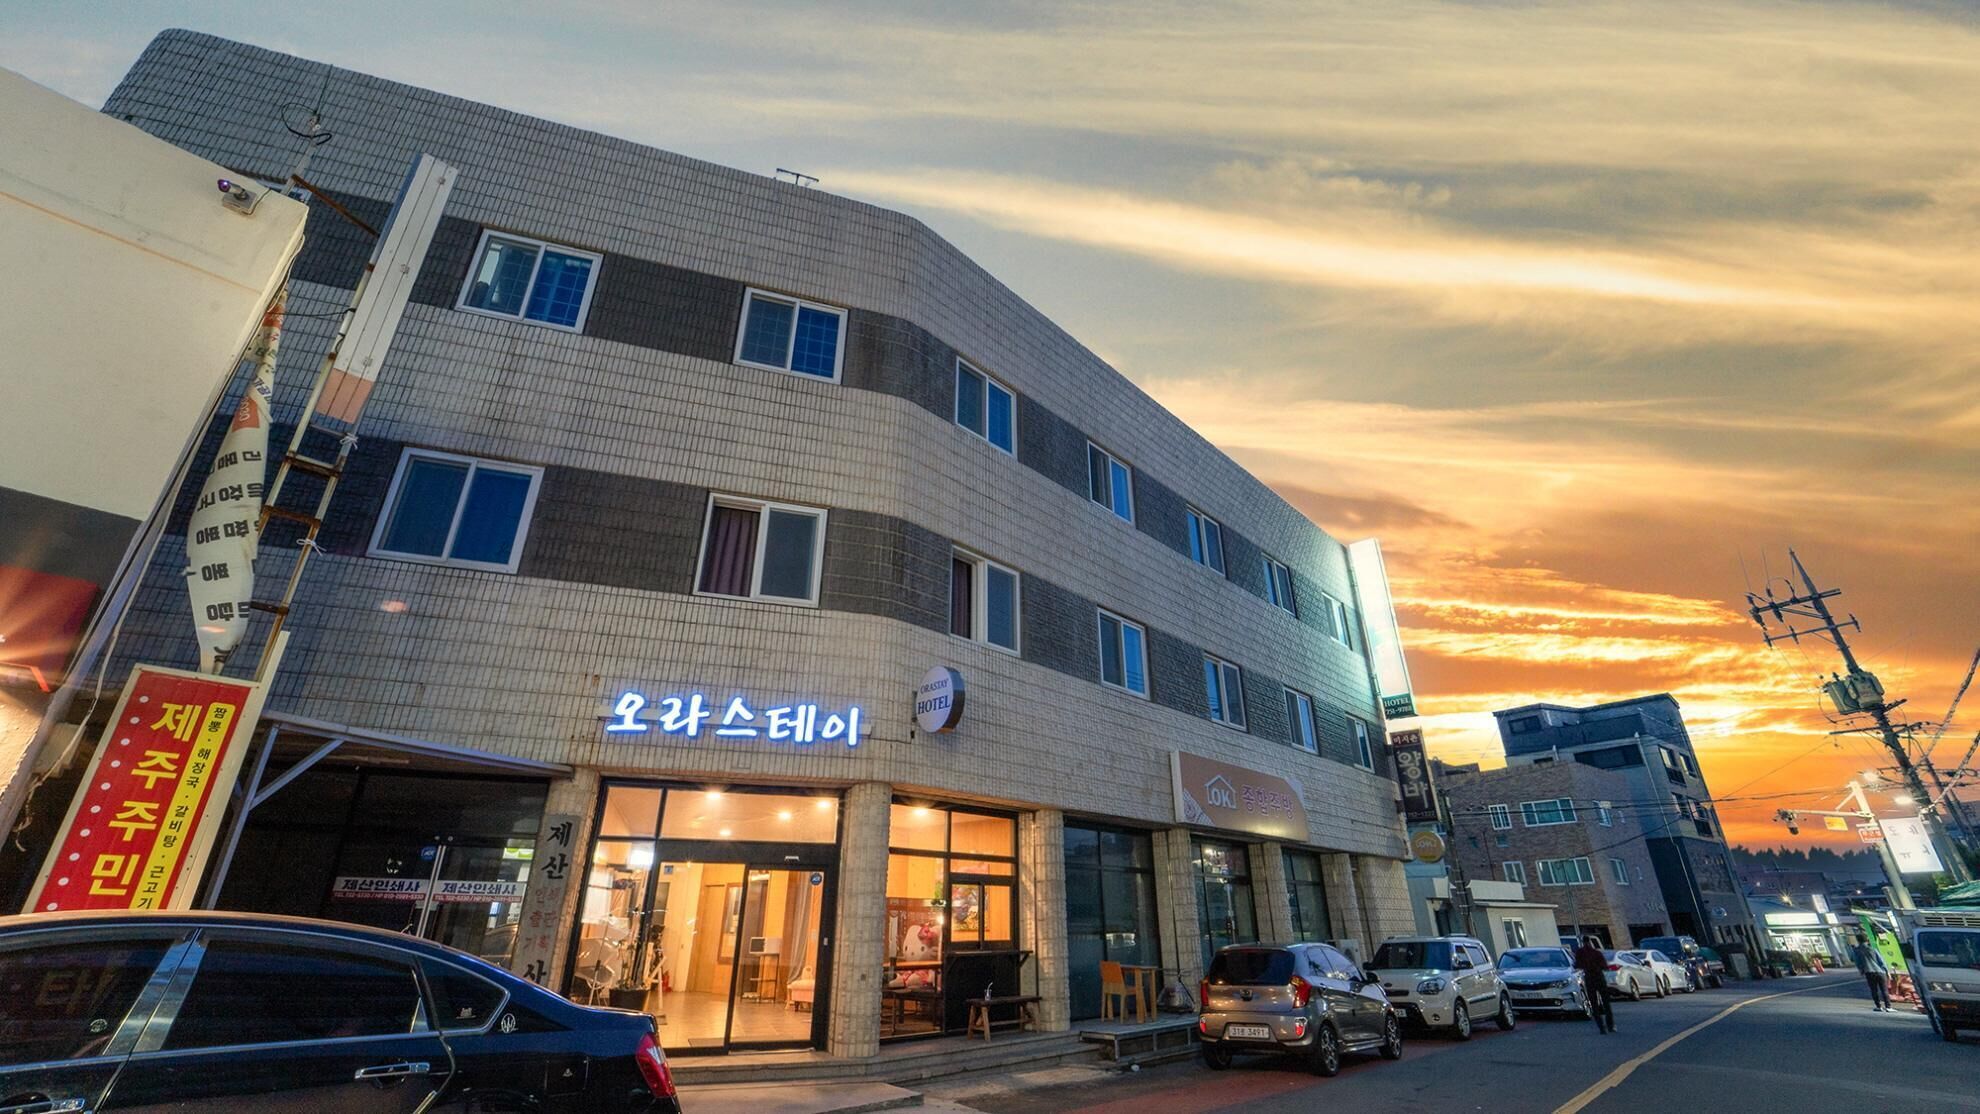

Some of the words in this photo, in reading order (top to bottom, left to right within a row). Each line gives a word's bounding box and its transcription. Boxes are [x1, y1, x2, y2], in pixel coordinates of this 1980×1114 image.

[919, 678, 950, 695] ORASTAY
[917, 695, 952, 716] HOTEL
[1384, 696, 1410, 708] HOTEL
[207, 706, 229, 734] 짬뽕
[606, 691, 861, 747] 오라스테이
[186, 748, 214, 789] 해장국
[88, 701, 203, 897] 제주주민
[1211, 787, 1232, 808] OK
[1240, 783, 1295, 821] 종합주방
[163, 804, 190, 849] 갈비탕
[541, 821, 573, 880] 제산
[342, 879, 421, 893] 제산인쇄사
[442, 882, 518, 895] 제산인쇄사
